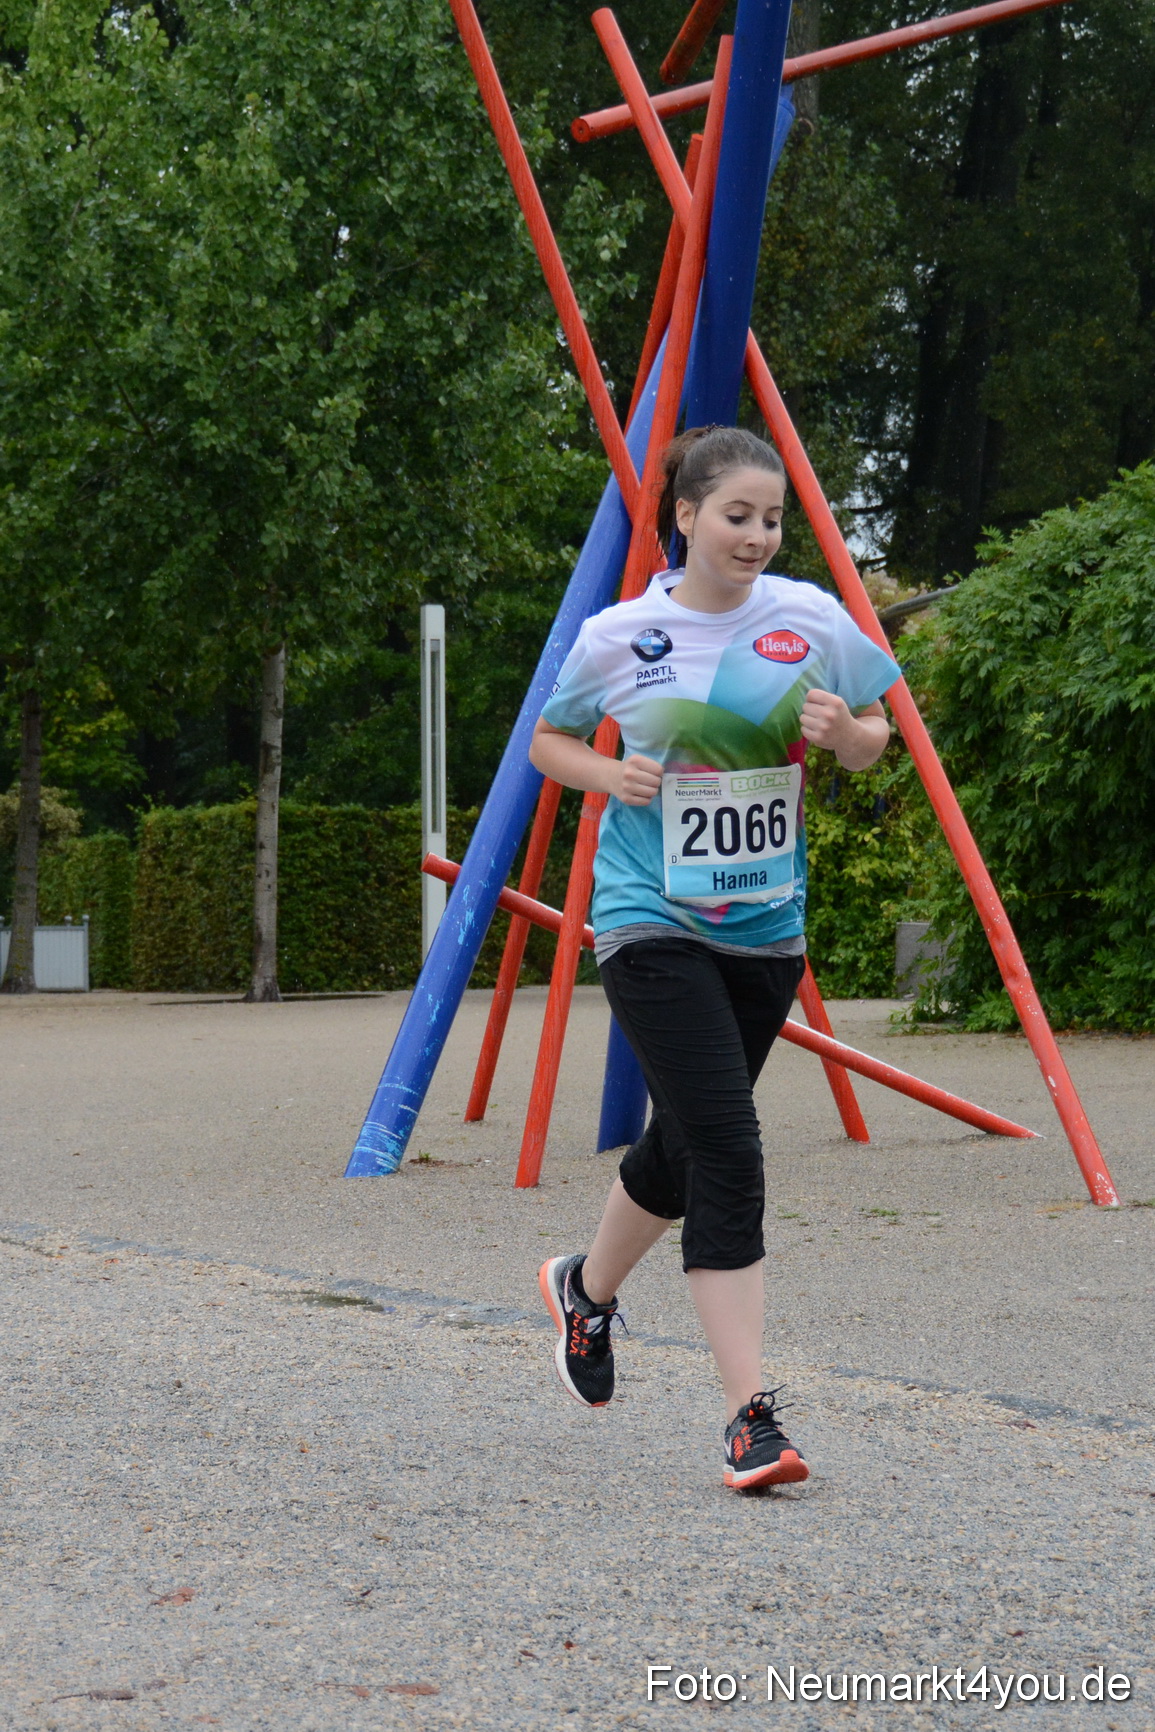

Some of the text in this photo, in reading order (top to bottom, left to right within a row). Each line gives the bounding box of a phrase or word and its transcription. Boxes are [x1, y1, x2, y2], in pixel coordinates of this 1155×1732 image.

[633, 629, 669, 642] BMW
[762, 638, 804, 655] Hervis
[636, 665, 676, 682] PARTL
[636, 676, 677, 689] Neumarkt
[730, 771, 792, 793] BOCK
[675, 789, 722, 797] NeuerMarkt
[681, 798, 787, 857] 2066
[712, 870, 768, 891] Hanna
